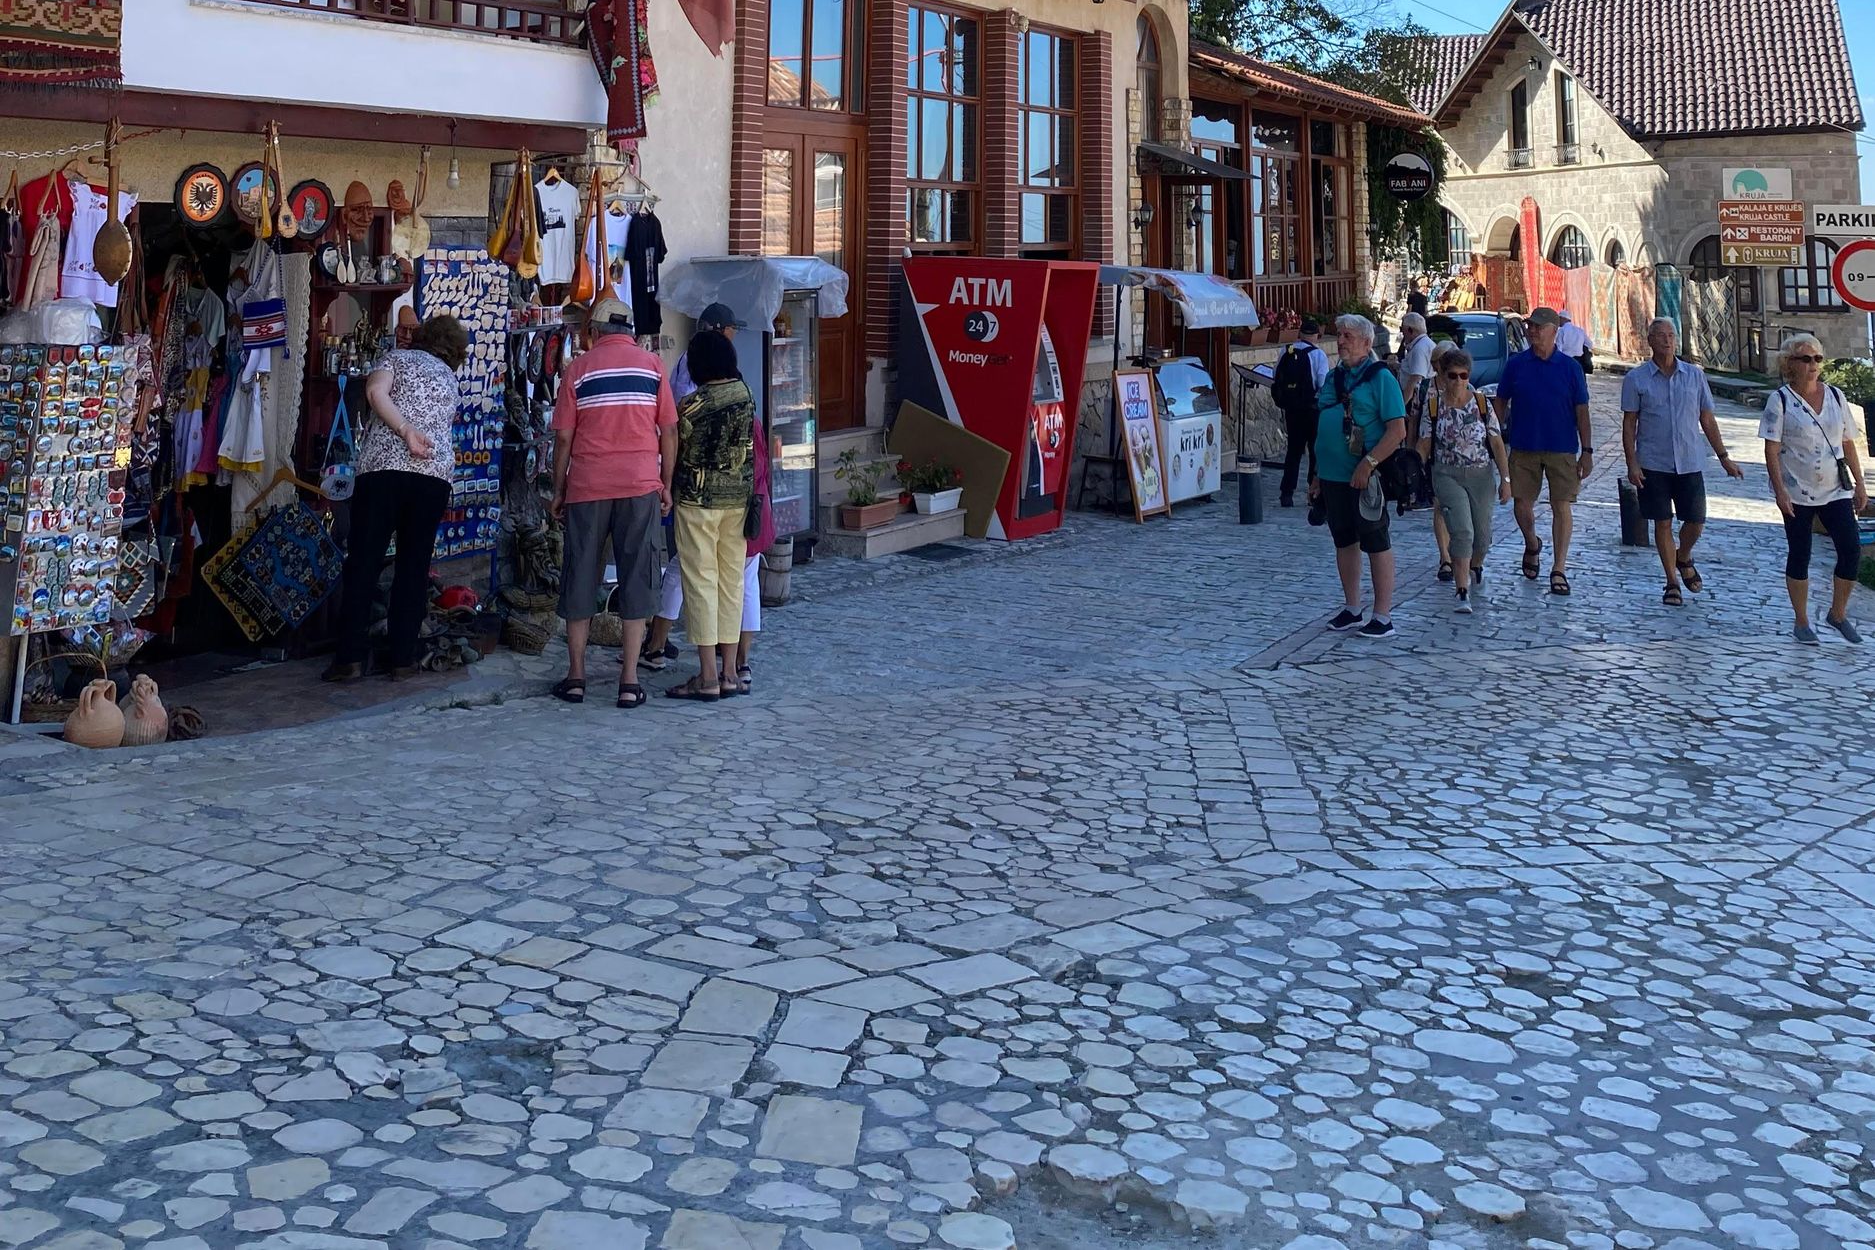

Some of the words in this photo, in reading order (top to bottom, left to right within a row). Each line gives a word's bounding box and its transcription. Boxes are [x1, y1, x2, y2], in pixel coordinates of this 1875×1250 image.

[1740, 213, 1762, 221] KRUJA
[1763, 213, 1791, 221] CASTLE
[1816, 213, 1875, 227] PARKI
[1750, 226, 1802, 235] RESTORANT
[1760, 234, 1793, 242] BARDHI
[1755, 249, 1789, 257] KRUJA
[948, 276, 1012, 308] ATM
[968, 319, 984, 333] 24
[989, 321, 997, 333] 7
[1127, 382, 1140, 400] ICE
[1124, 401, 1148, 419] CREAM
[1044, 413, 1063, 430] ATM
